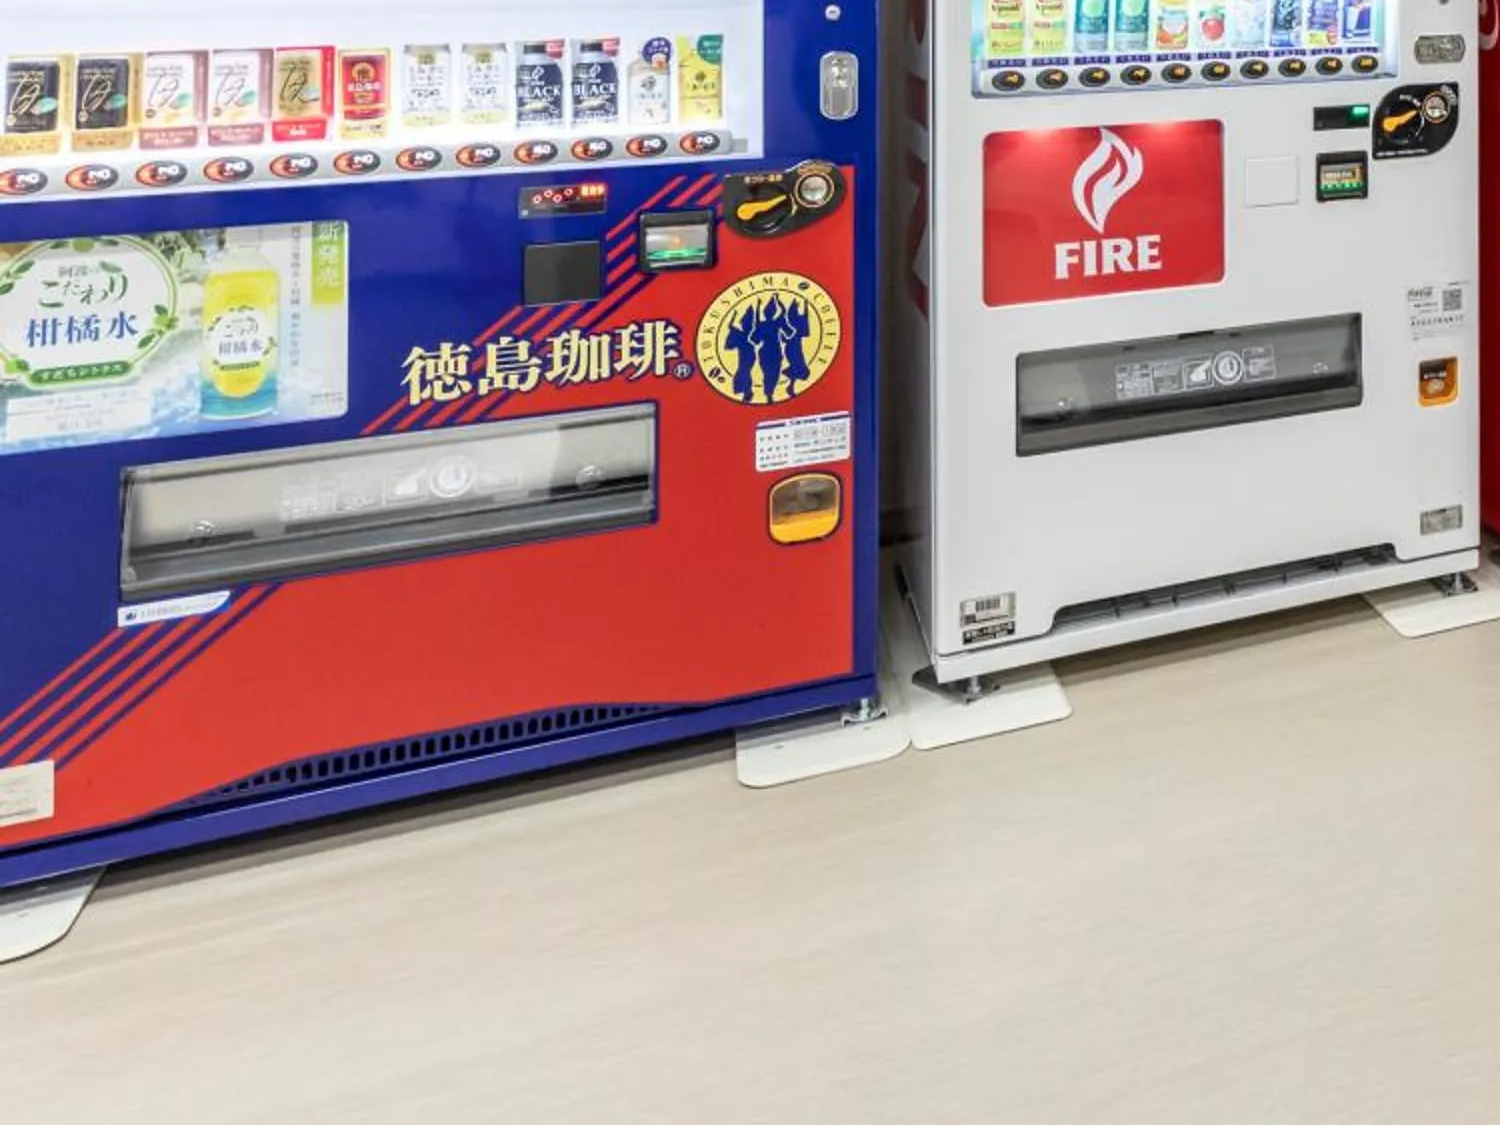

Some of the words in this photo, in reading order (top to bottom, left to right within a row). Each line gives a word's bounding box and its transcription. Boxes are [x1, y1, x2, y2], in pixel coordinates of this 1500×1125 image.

[1054, 234, 1162, 281] FIRE
[38, 275, 129, 308] こだわり
[27, 311, 139, 348] 柑橘水
[401, 320, 680, 406] 徳島珈琲
